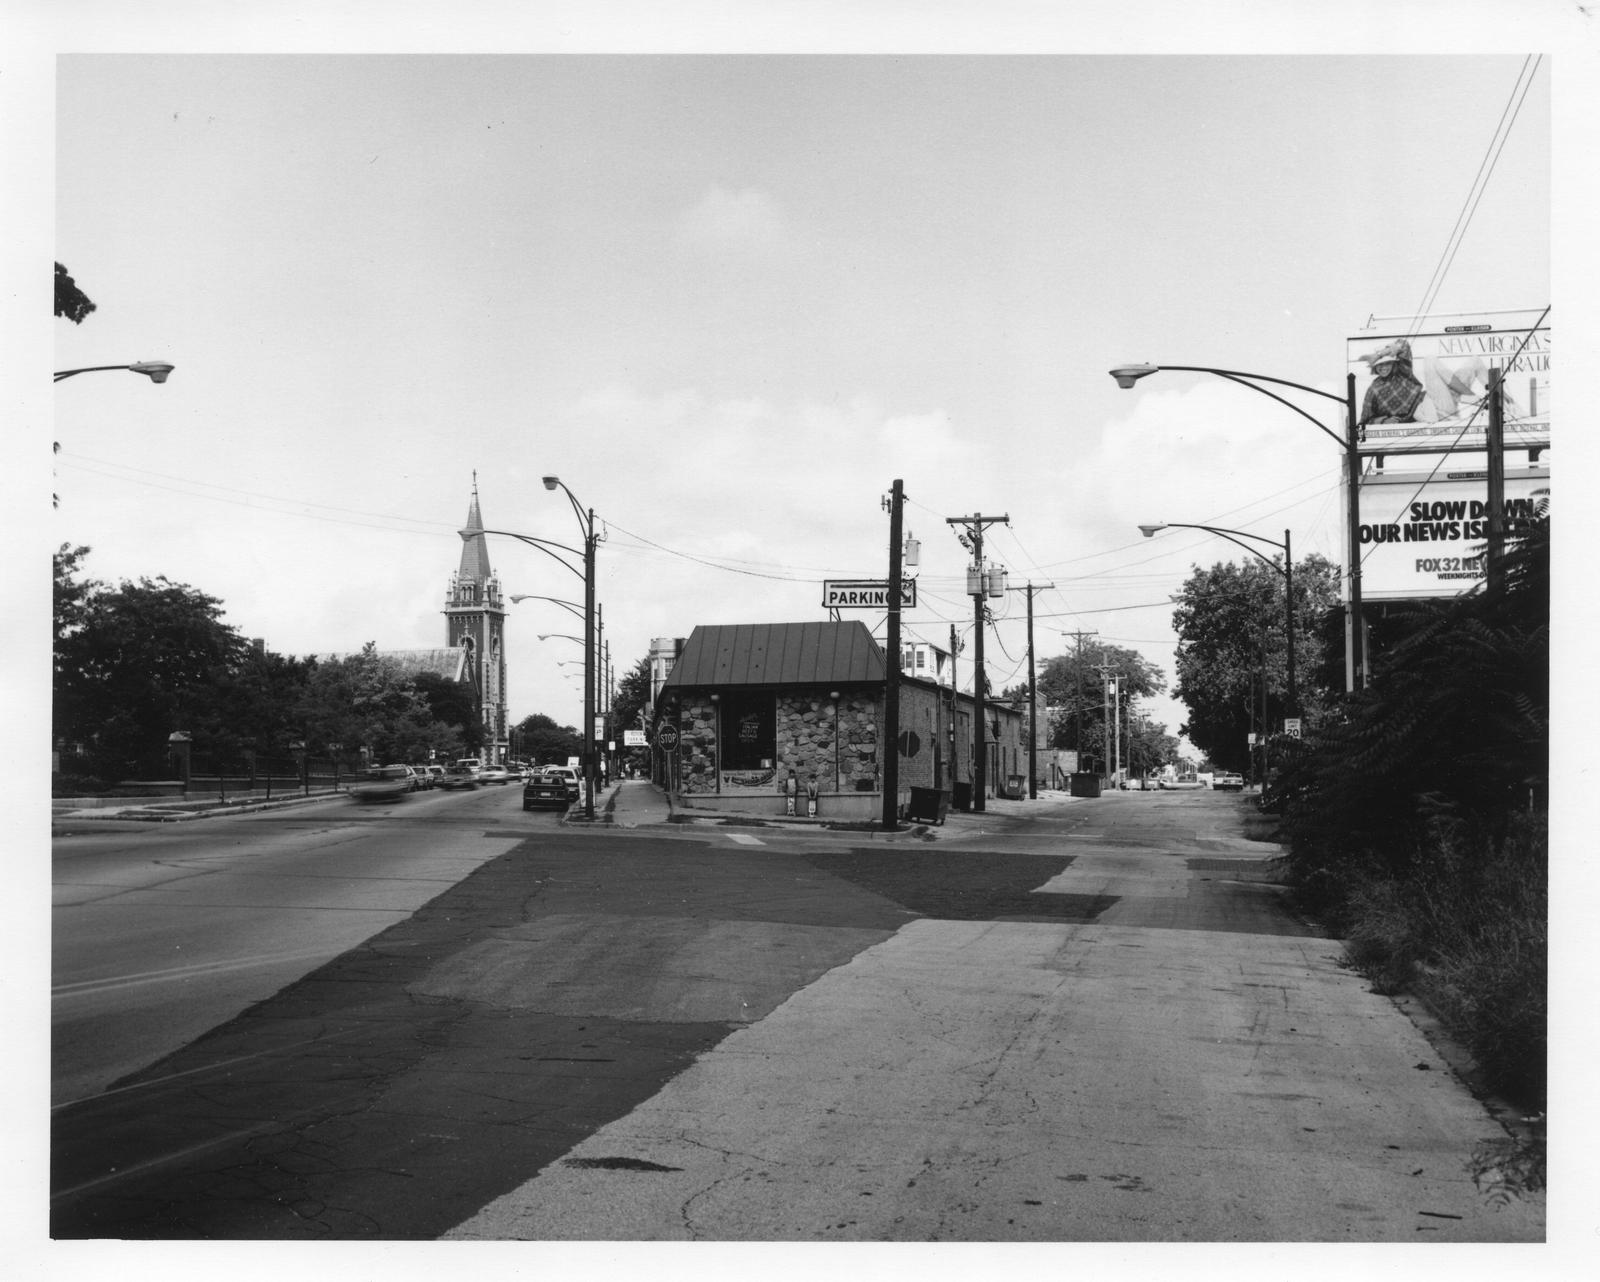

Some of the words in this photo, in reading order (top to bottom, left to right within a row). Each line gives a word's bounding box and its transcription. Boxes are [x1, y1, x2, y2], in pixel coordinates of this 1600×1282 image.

[1439, 337, 1475, 354] NEW
[1478, 334, 1540, 352] VIRGINIA
[1410, 500, 1467, 521] SLOW
[1359, 524, 1401, 544] OUR
[1403, 521, 1460, 542] NEWS
[1416, 558, 1443, 573] FOX
[1443, 557, 1460, 571] 32
[829, 591, 889, 604] PARKIN
[660, 732, 677, 744] STOP
[1287, 728, 1299, 737] 20
